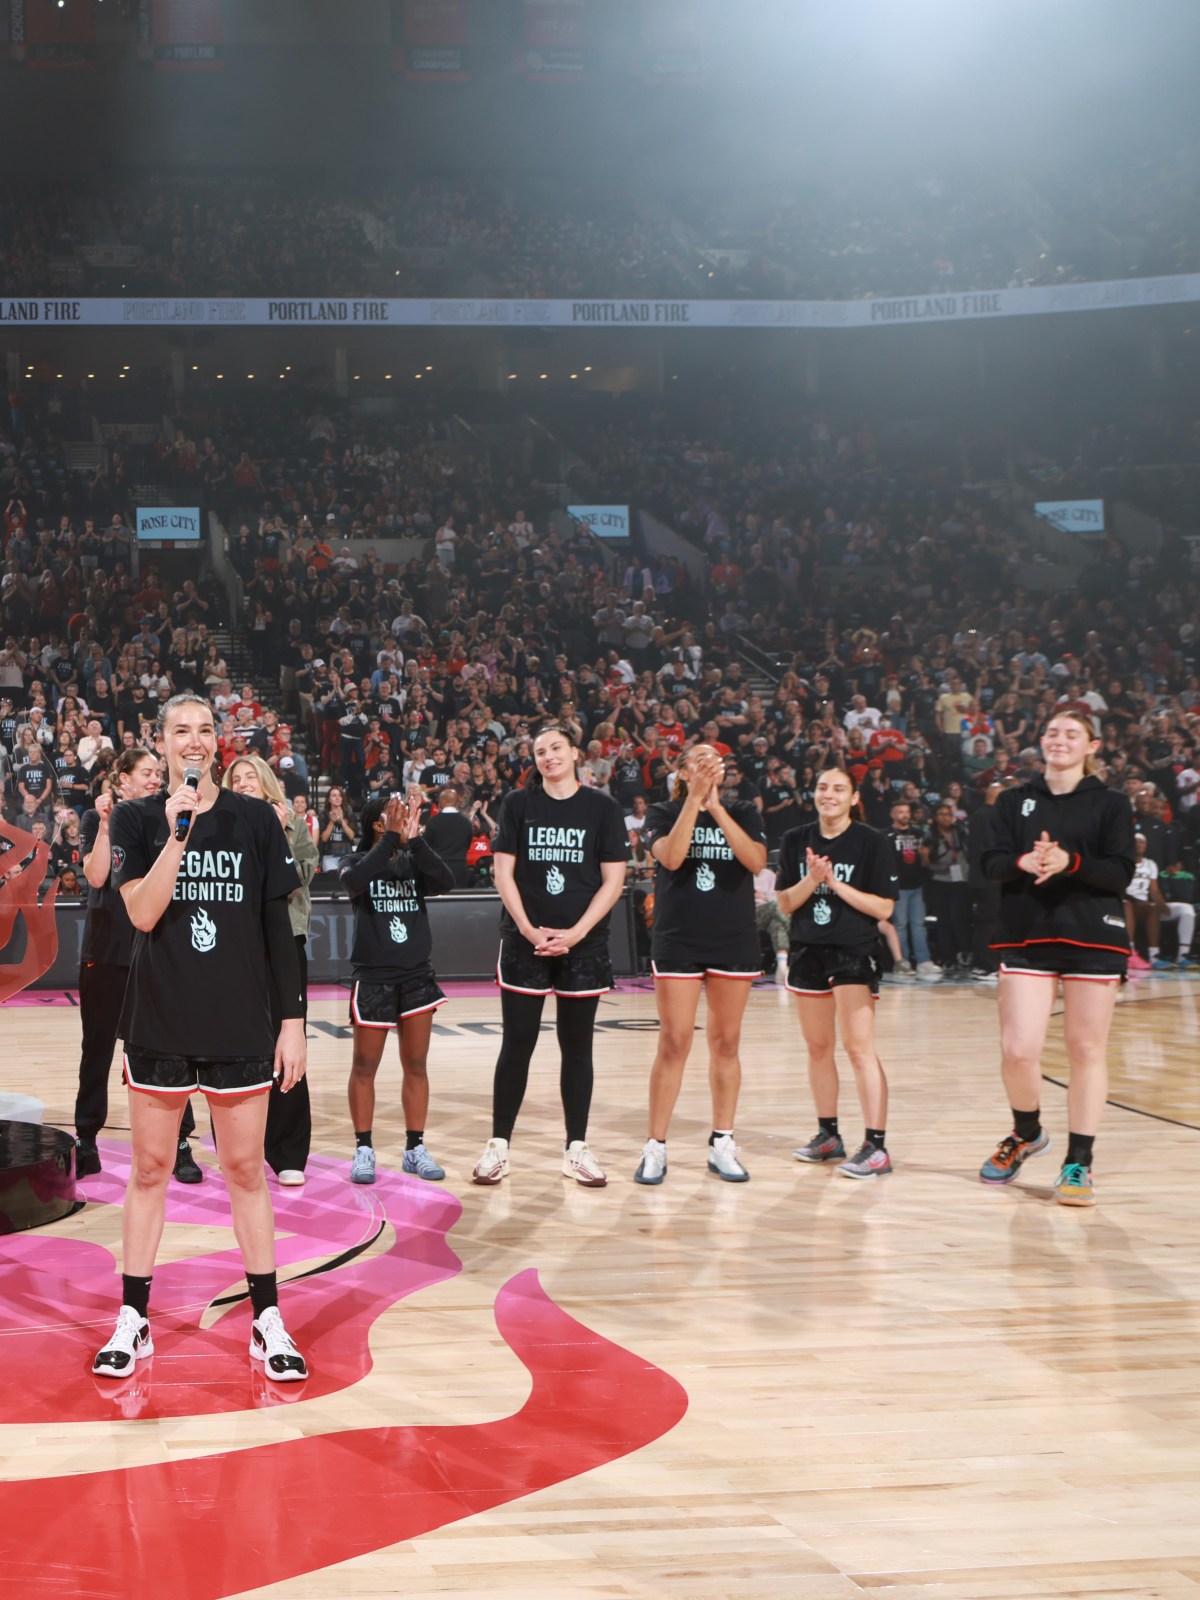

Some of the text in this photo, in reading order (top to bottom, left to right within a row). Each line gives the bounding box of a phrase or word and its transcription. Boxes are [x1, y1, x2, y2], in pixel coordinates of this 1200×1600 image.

[44, 301, 81, 320] FIRE
[123, 301, 245, 320] PORTLAND FIRE
[268, 301, 389, 320] PORTLAND FIRE
[430, 302, 550, 321] PORTLAND FIRE
[572, 303, 689, 322] PORTLAND FIRE
[871, 294, 1001, 321] PORTLAND FIRE
[140, 515, 197, 532] ROSE CITY
[601, 514, 625, 529] CITY
[1072, 507, 1101, 524] CITY
[2, 720, 16, 729] FIRE
[26, 770, 43, 779] FIRE
[432, 774, 450, 785] FIRE
[528, 826, 587, 849] LEGACY
[528, 847, 585, 864] REIGNITED
[173, 881, 244, 903] EIGNITED
[369, 878, 418, 899] LEGACY
